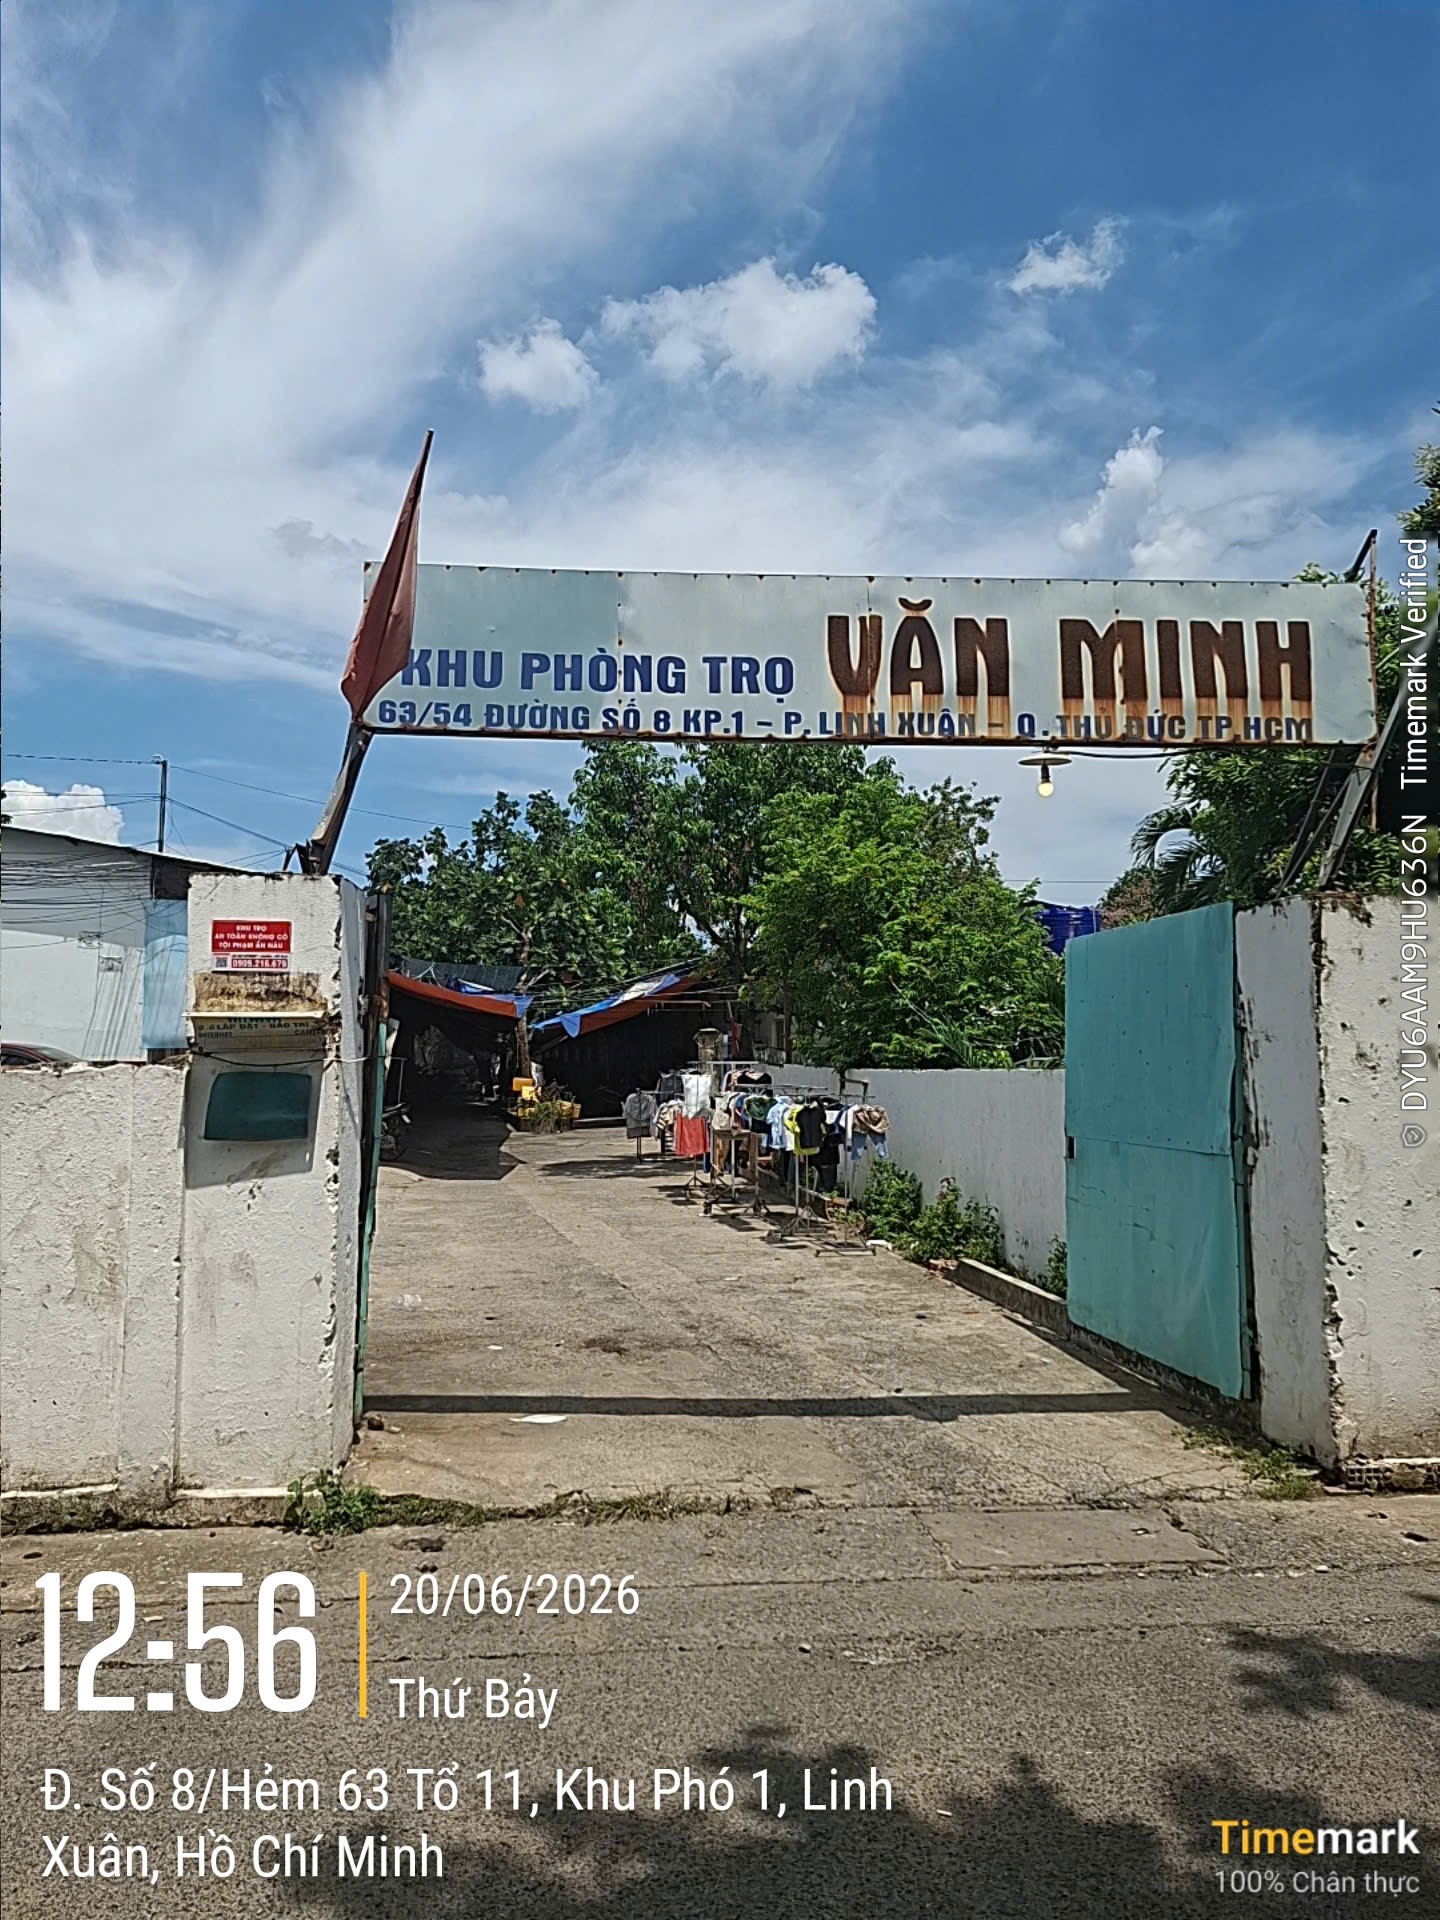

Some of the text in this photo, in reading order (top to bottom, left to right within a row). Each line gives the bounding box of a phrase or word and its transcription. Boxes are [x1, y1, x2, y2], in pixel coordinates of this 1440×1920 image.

[401, 647, 794, 704] KHU PHÒNG TRỌ
[827, 597, 1313, 700] VĂN MINH
[378, 700, 472, 727] 63/54
[483, 699, 590, 730] ĐƯỜNG
[602, 698, 641, 731] SỐ
[653, 710, 671, 733] 8
[683, 709, 743, 734] KP.1
[784, 711, 811, 735] P.
[819, 711, 886, 737] LINH
[897, 708, 975, 737] XUÂN
[1017, 713, 1049, 738] Q.
[1056, 706, 1112, 739] THỦ
[1124, 709, 1186, 740] ĐỨC
